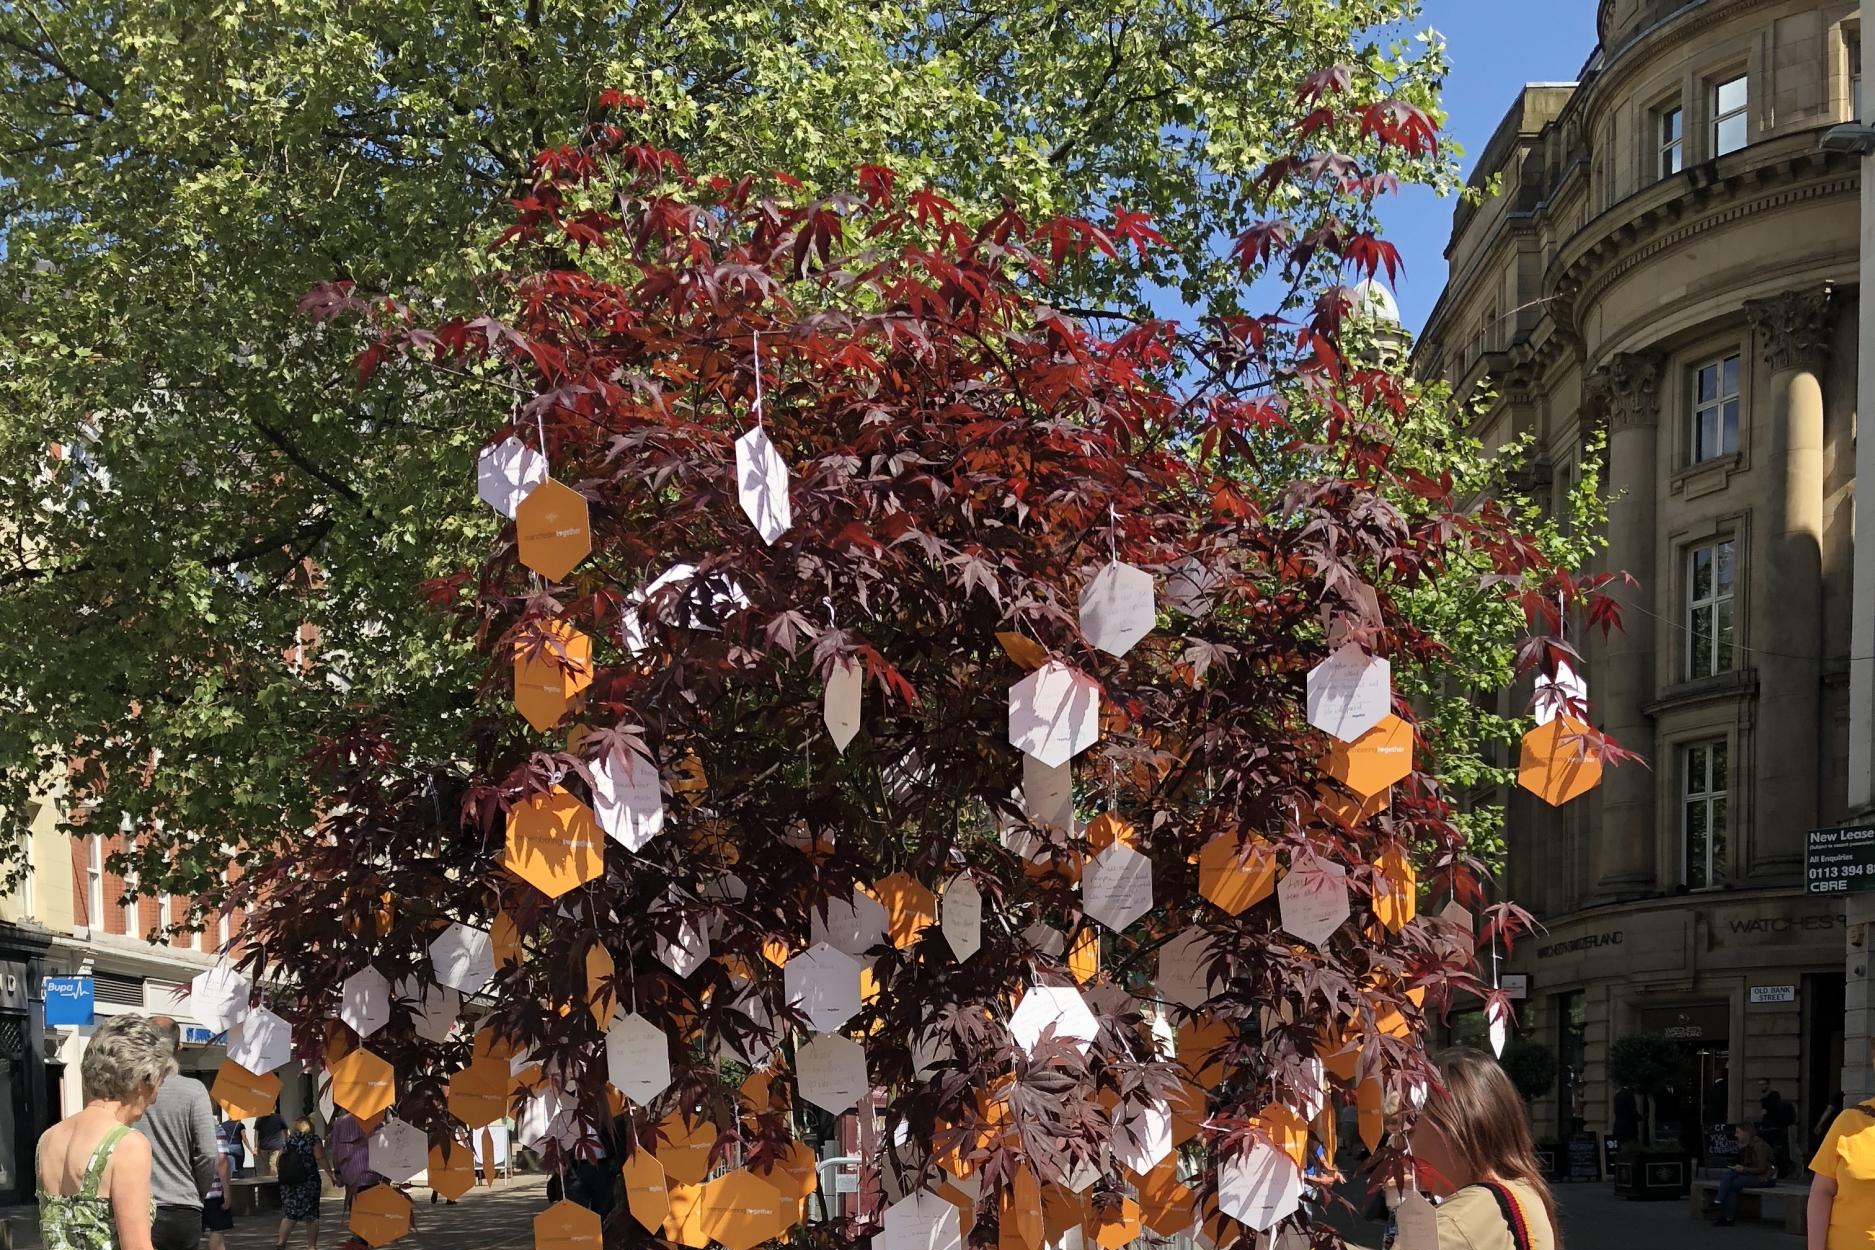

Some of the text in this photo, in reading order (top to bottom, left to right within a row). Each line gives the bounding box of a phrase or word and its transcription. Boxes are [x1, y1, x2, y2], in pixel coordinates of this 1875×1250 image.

[1810, 830, 1875, 843] New Lease
[1820, 854, 1854, 863] Enquiries
[1809, 866, 1839, 879] 0113
[1841, 864, 1864, 877] 394
[1810, 880, 1848, 892] CBRE
[1729, 916, 1834, 934] WATCHES
[47, 982, 74, 993] Bupa
[1771, 986, 1791, 994] BANK
[1759, 993, 1786, 1001] STREET
